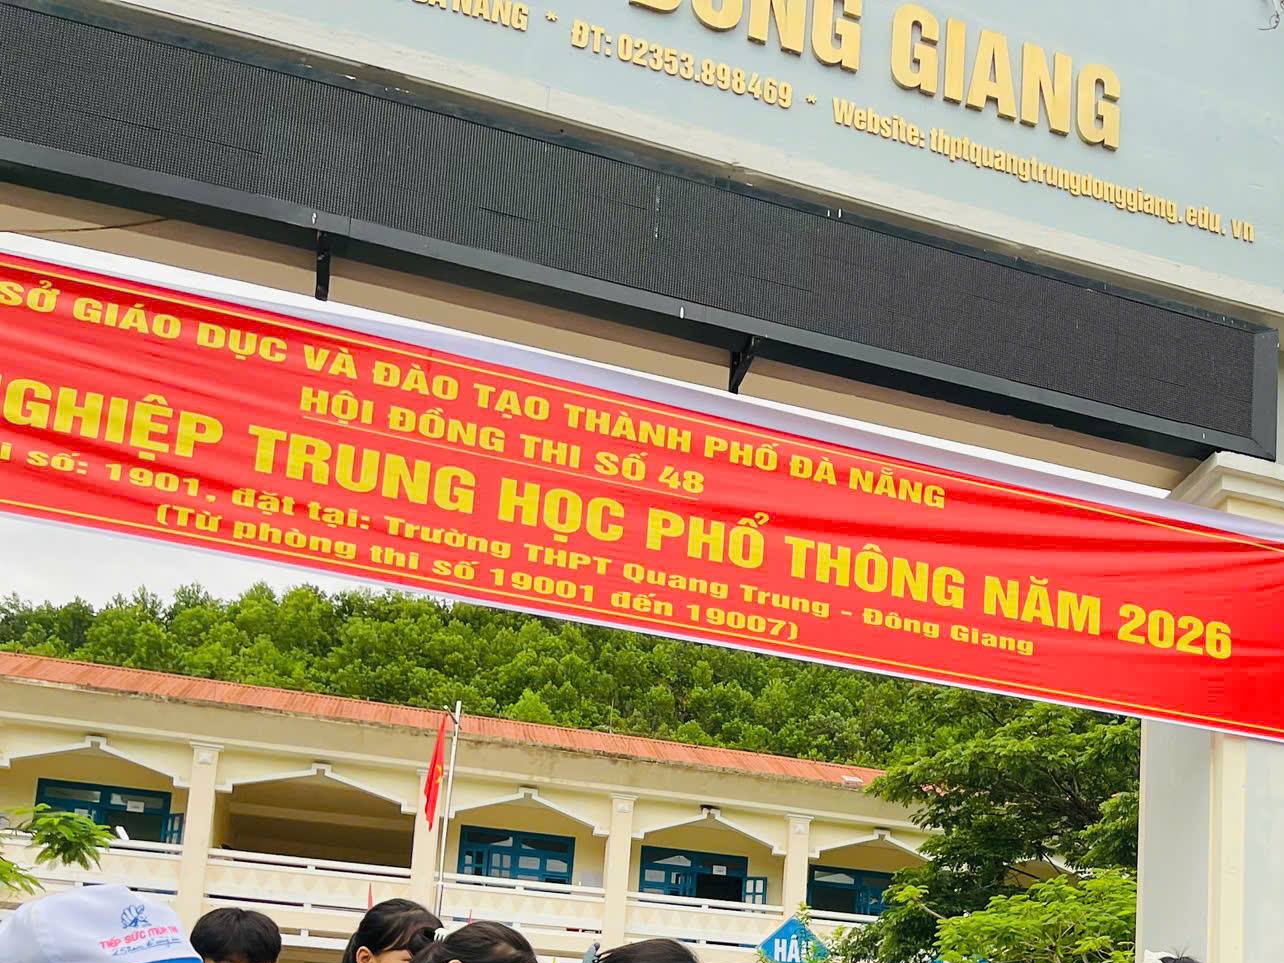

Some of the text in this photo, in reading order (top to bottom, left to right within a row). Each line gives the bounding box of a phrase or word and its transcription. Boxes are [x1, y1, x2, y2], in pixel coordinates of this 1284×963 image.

[831, 96, 926, 148] Website:
[889, 3, 1121, 151] GIANG
[0, 280, 944, 509] SỞ GIÁO DỤC VÀ ĐÀO TẠO THÀNH PHỐ ĐÀ NẴNG
[299, 386, 704, 496] HỘI ĐỒNG THI SỐ 48
[0, 379, 1231, 659] GHIỆP TRUNG HỌC PHỔ THÔNG NĂM 2026
[27, 450, 87, 474] số:
[232, 488, 295, 516] đặt
[308, 501, 370, 530] tại:
[385, 516, 511, 559] Trường
[524, 544, 612, 575] THPT
[623, 563, 728, 599] Quang
[740, 584, 830, 618] Trung
[862, 608, 940, 639] Đông
[950, 624, 1033, 656] Giang
[156, 504, 798, 638] (Từ phòng thi số 19001 đến 19007)
